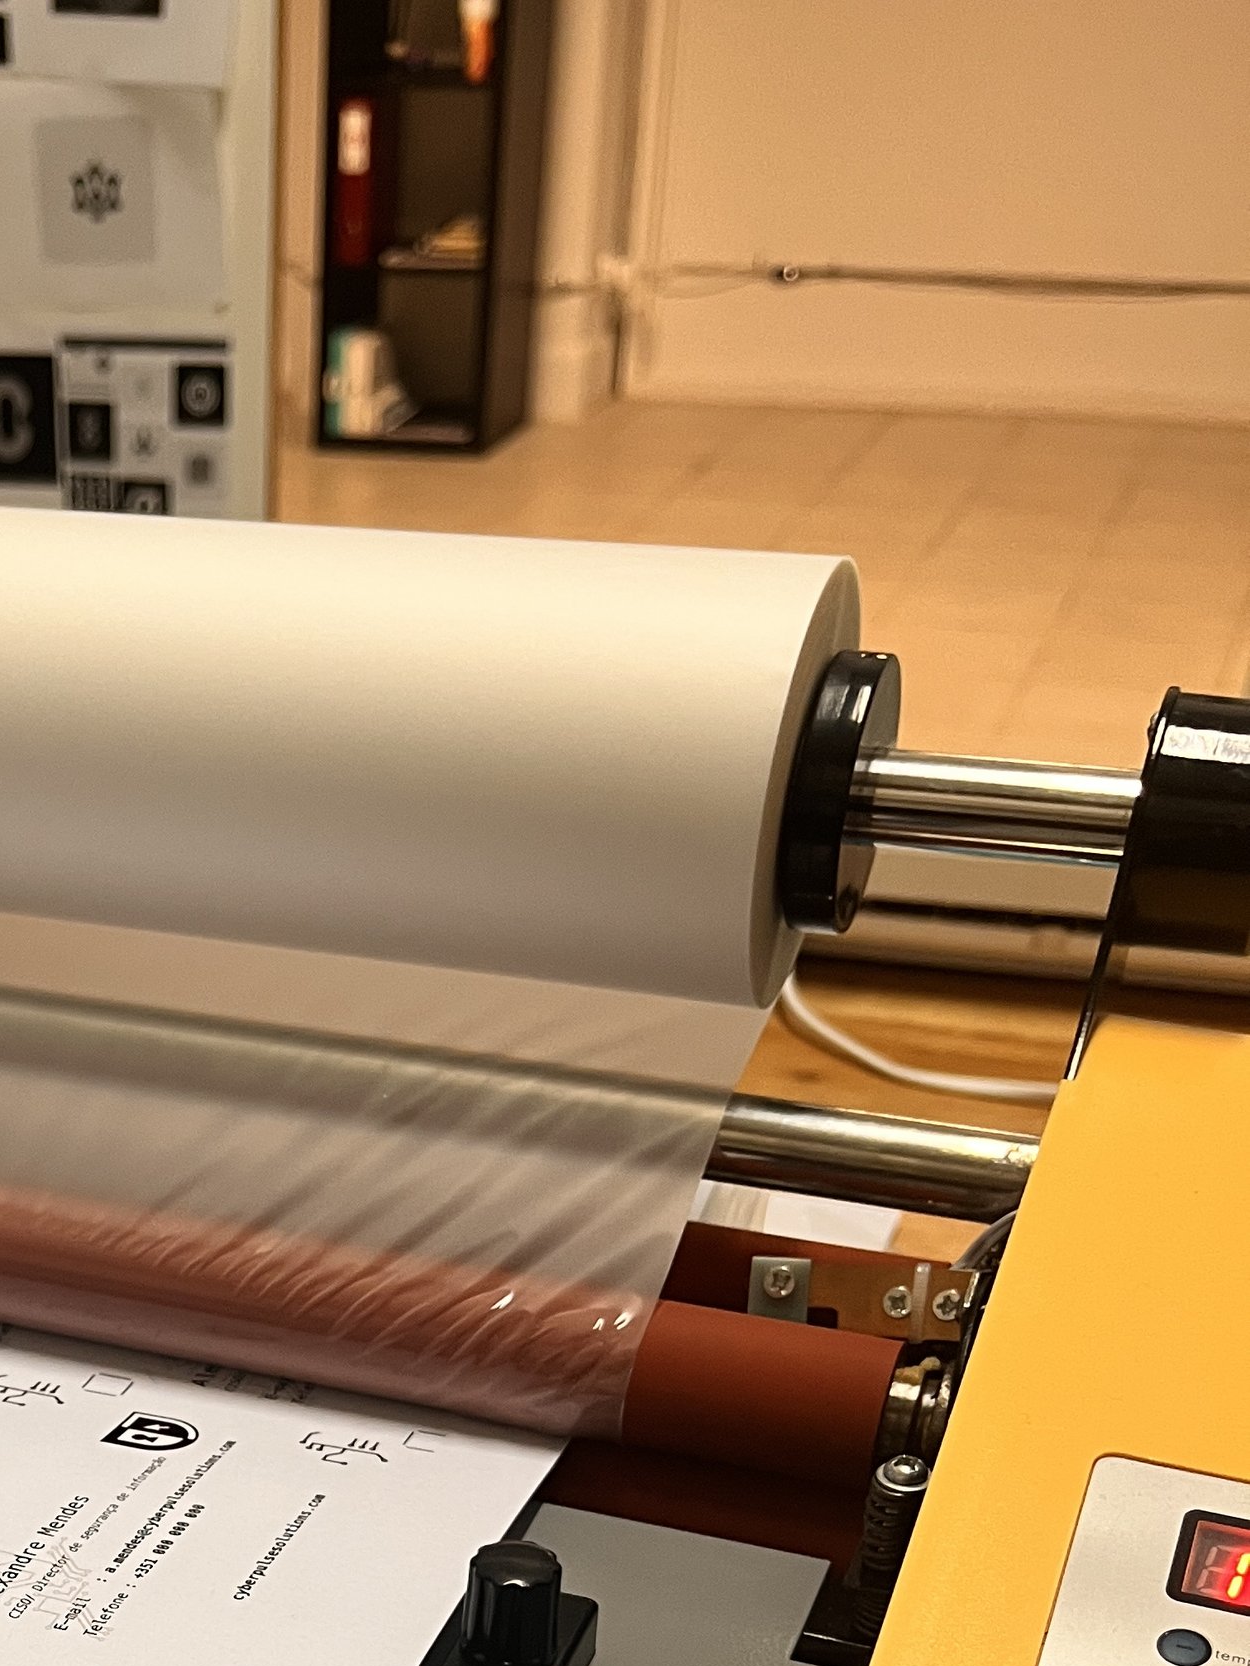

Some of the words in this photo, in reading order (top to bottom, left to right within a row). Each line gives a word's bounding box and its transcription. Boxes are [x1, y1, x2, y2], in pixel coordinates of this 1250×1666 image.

[36, 1495, 90, 1538] Mendes
[8, 1593, 36, 1619] CISO/
[31, 1554, 70, 1592] Director
[82, 1592, 129, 1636] Telefone
